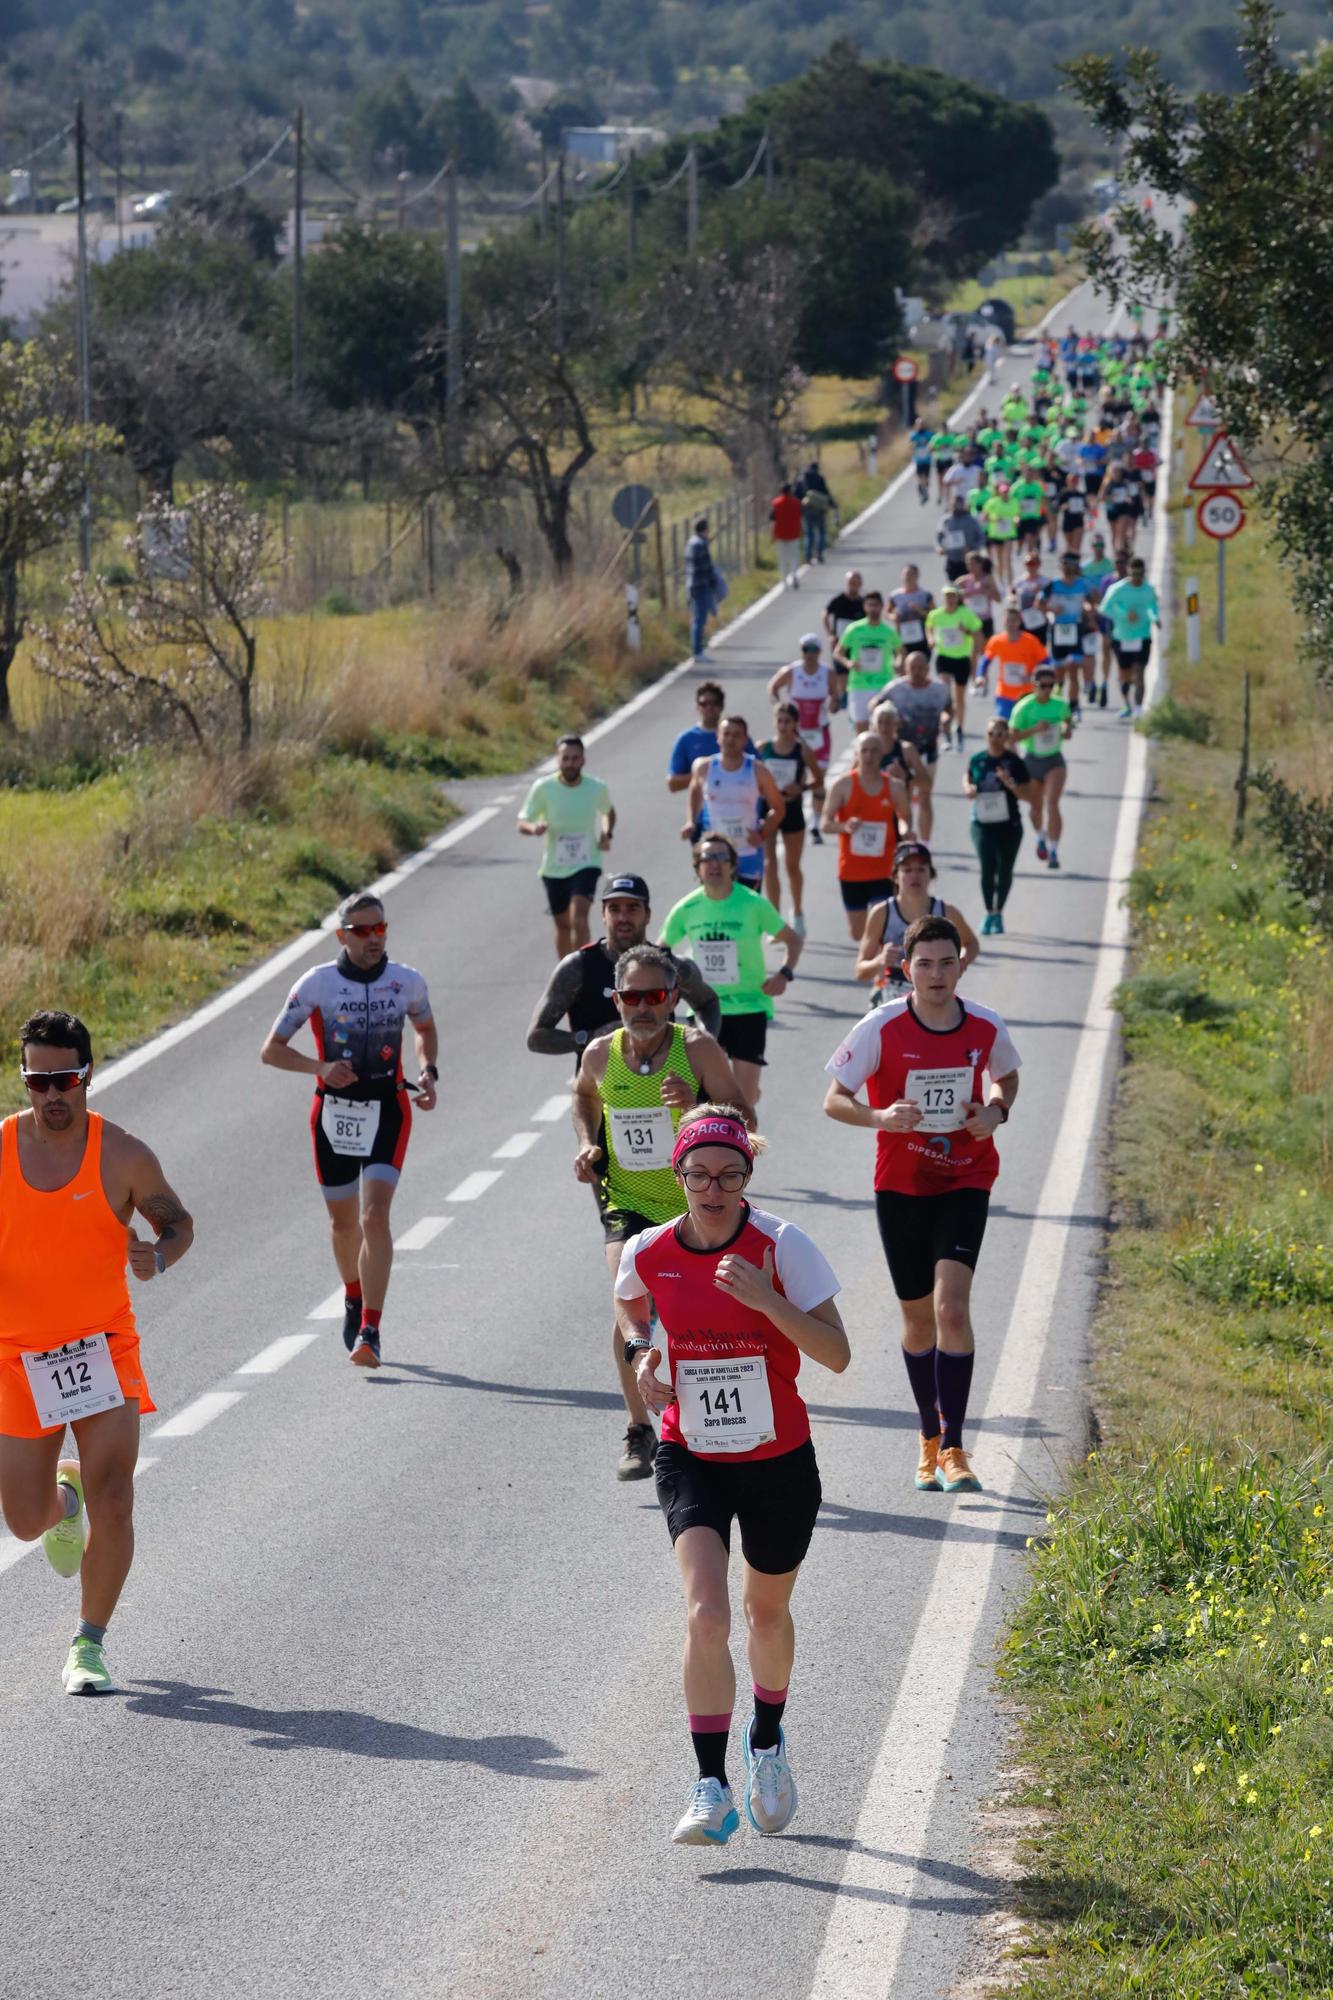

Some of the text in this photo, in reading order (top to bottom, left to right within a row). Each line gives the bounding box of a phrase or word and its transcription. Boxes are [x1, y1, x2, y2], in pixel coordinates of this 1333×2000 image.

[1209, 507, 1236, 525] 50
[705, 954, 725, 967] 109
[340, 999, 397, 1012] ACOSTA
[923, 1088, 954, 1106] 173
[336, 1120, 362, 1138] 138
[624, 1127, 653, 1146] 131
[85, 1341, 97, 1350] 2023
[51, 1361, 92, 1390] 112
[698, 1367, 710, 1376] FLOR
[740, 1364, 754, 1373] 2023
[60, 1384, 92, 1399] Xavier Rus
[700, 1387, 742, 1415] 141
[704, 1416, 747, 1428] Sara Illescas
